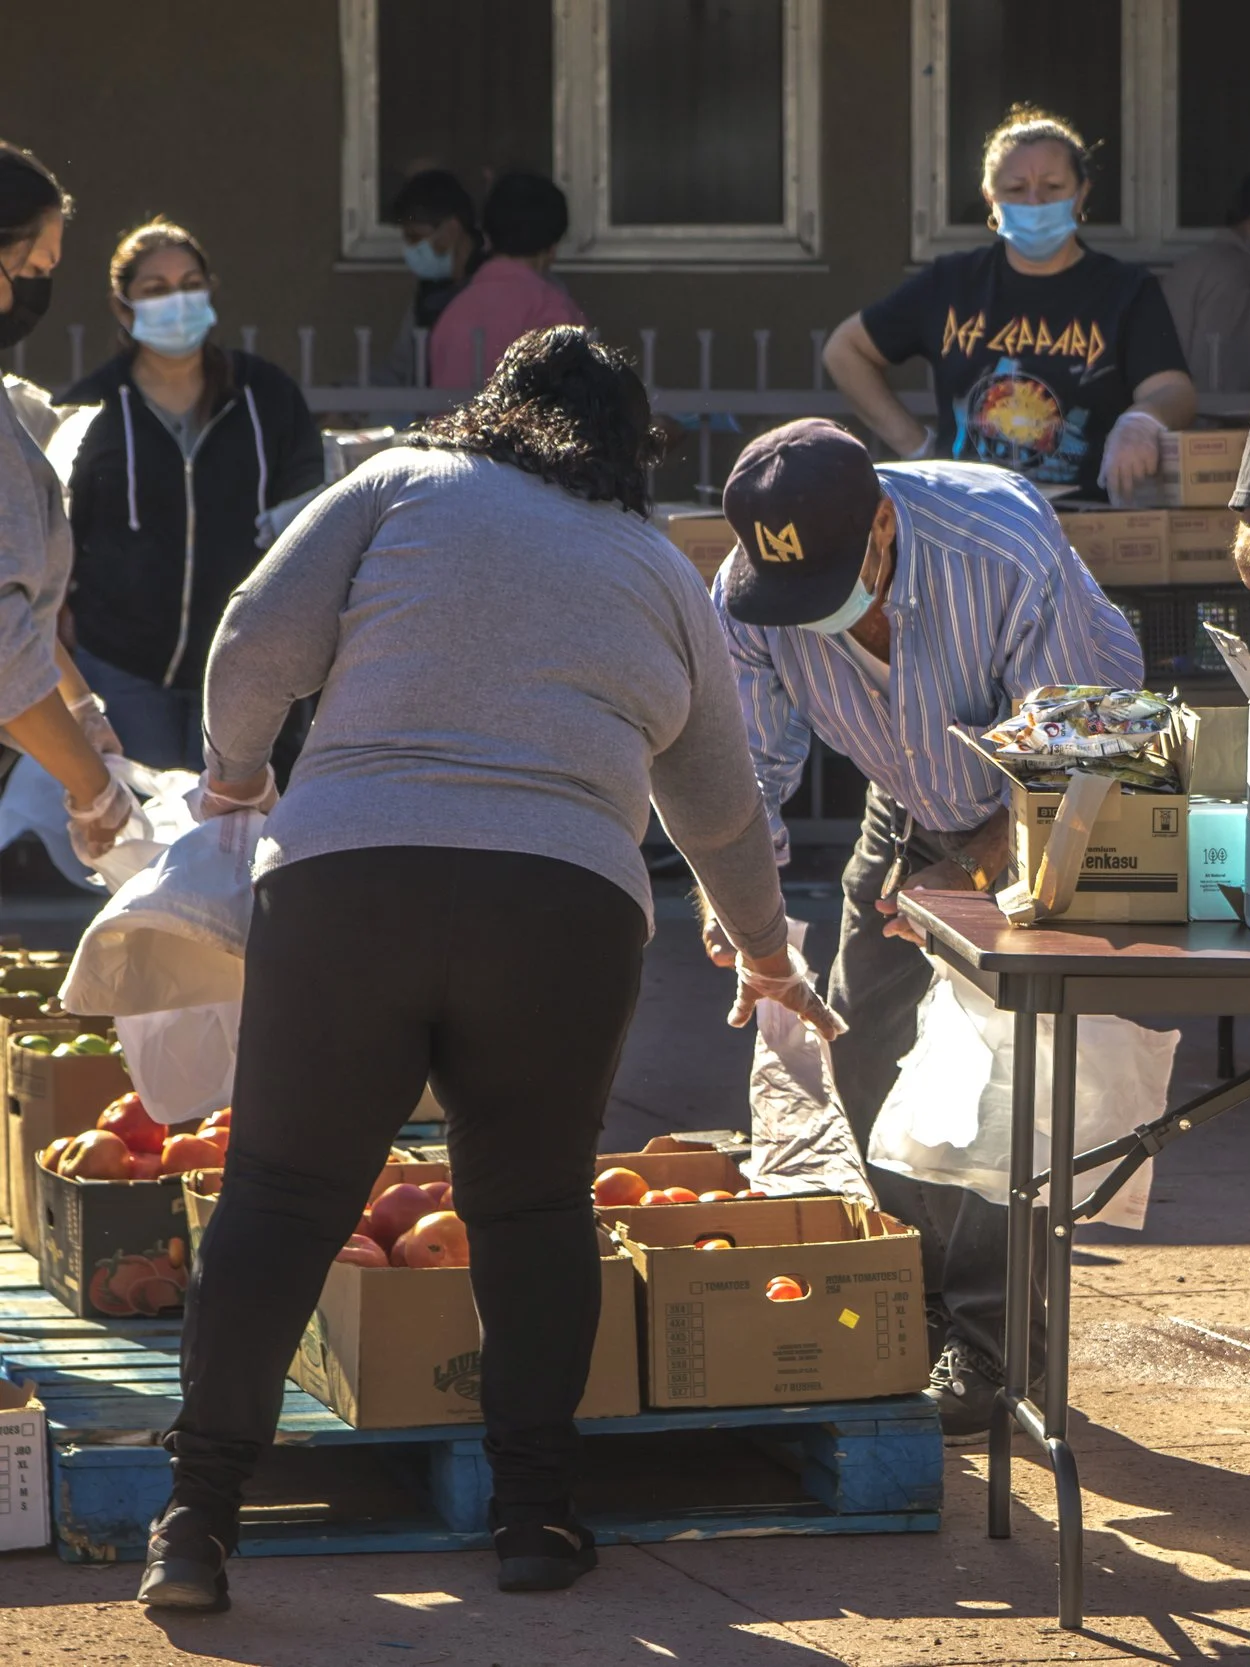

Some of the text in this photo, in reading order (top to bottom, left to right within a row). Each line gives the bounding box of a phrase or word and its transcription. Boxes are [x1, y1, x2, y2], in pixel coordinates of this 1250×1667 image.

[941, 304, 1106, 369] DEF LEPPARD
[853, 1272, 898, 1283] TOMATOES
[705, 1281, 750, 1291] TOMATOES
[18, 1460, 29, 1469] XL
[21, 1475, 26, 1483] L
[20, 1488, 28, 1497] M
[21, 1502, 27, 1511] S
